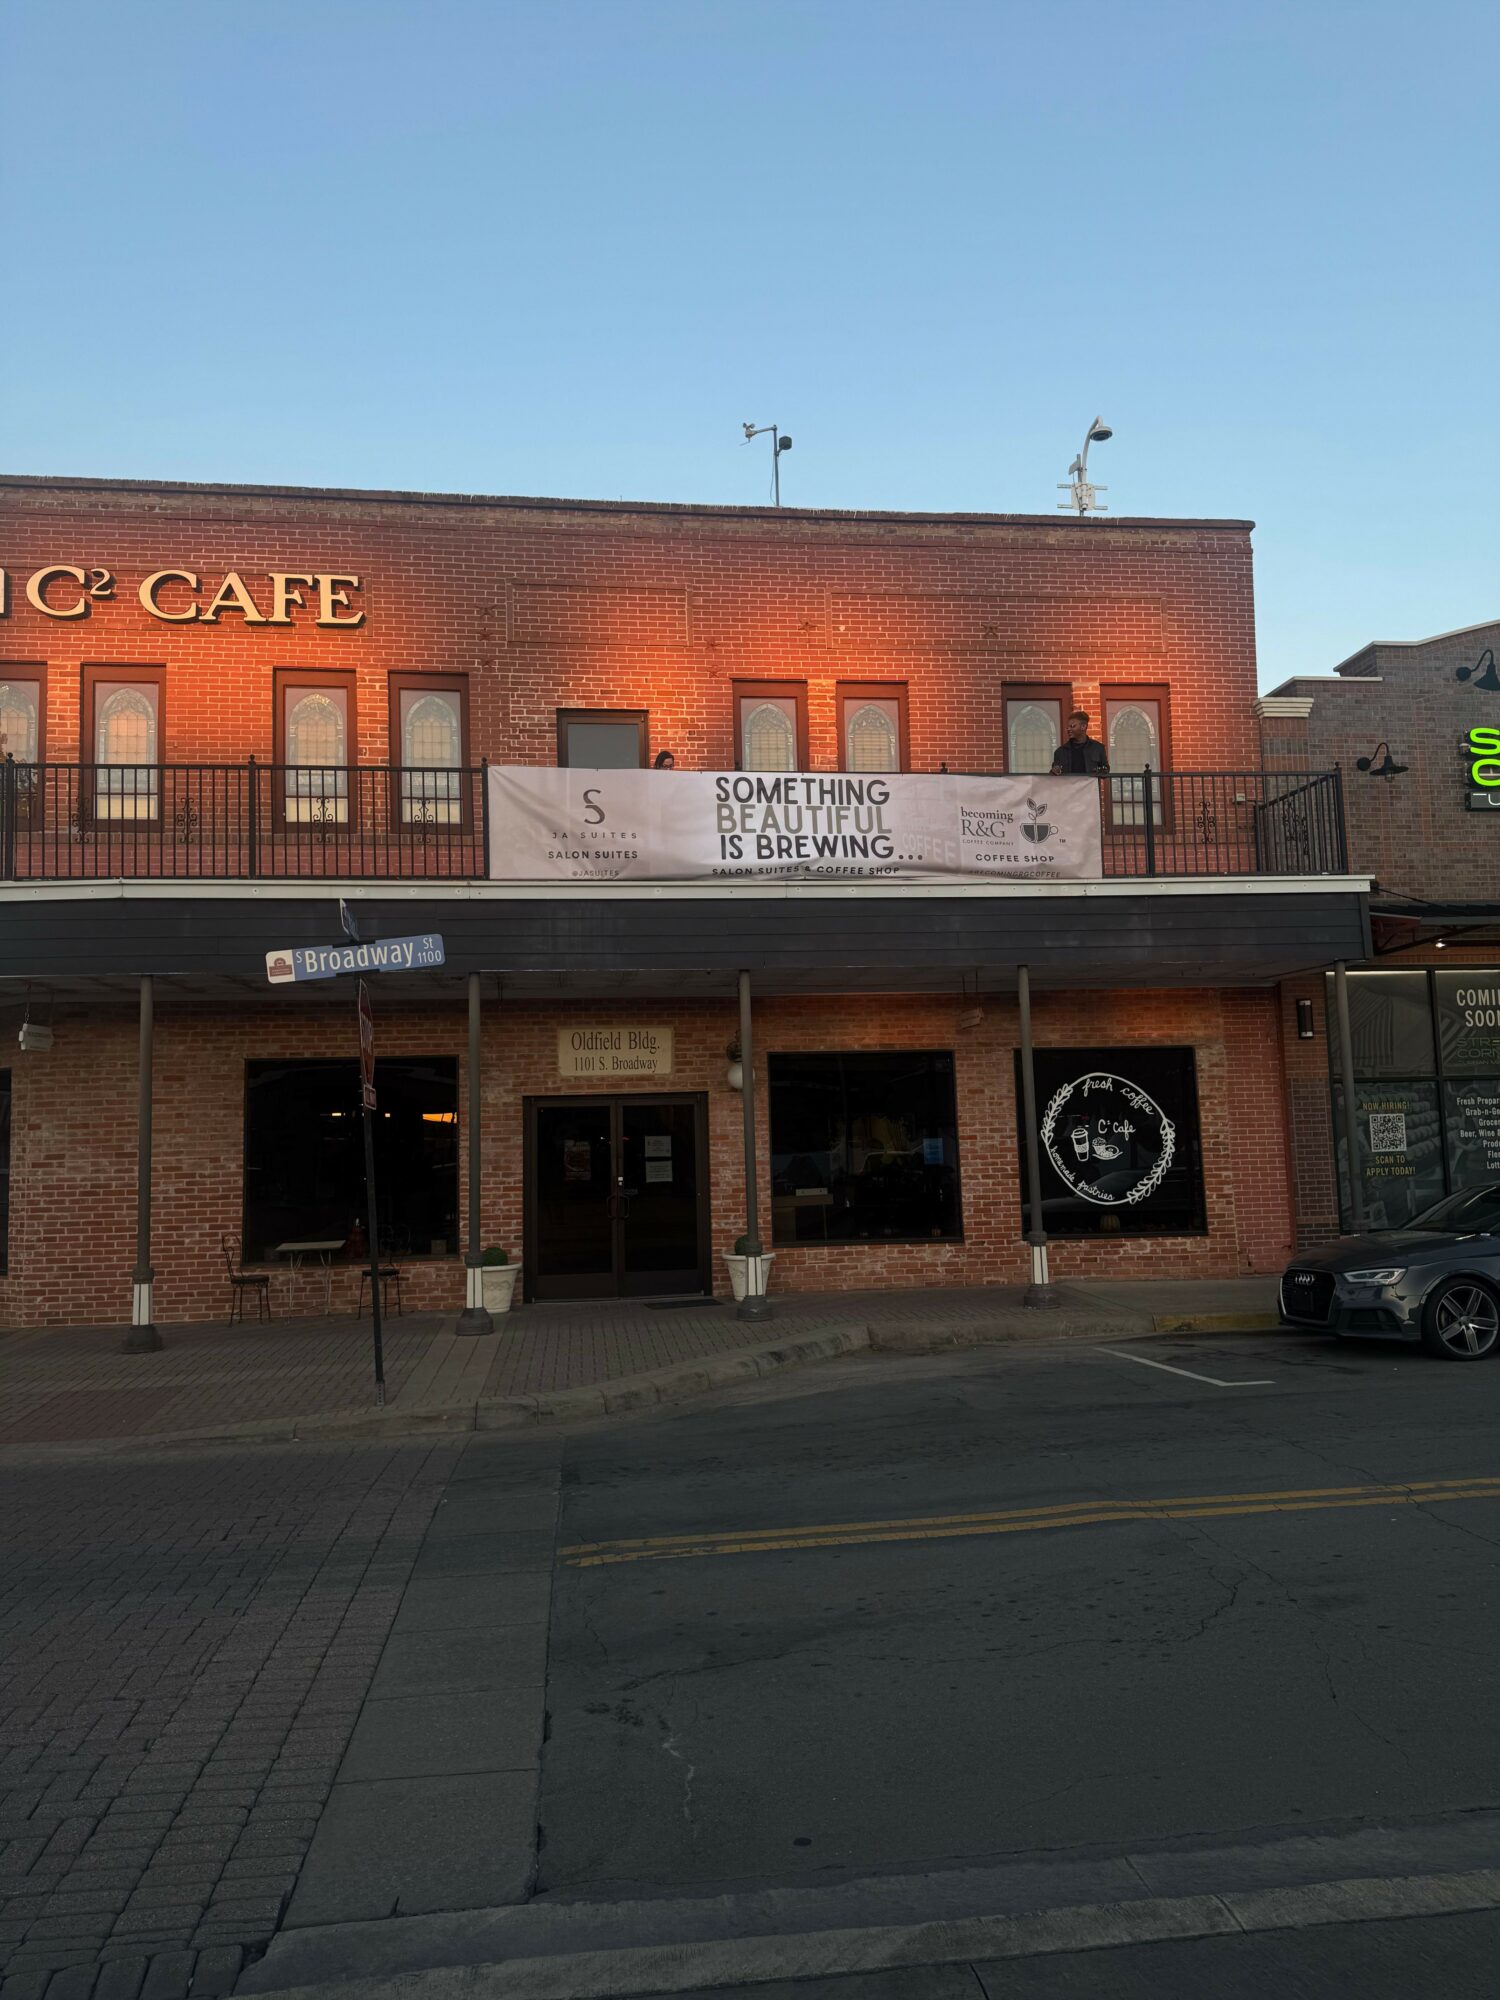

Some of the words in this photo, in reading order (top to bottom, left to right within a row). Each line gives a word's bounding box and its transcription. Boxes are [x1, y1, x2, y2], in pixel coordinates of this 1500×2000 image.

[139, 569, 365, 624] CAFE
[716, 776, 890, 806] SOMETHING
[717, 804, 892, 835] BEAUTIFUL
[960, 806, 1014, 824] becoming
[960, 819, 1006, 839] R&G
[548, 850, 590, 859] SALON
[595, 850, 639, 859] SUITES
[720, 834, 743, 860] IS
[975, 853, 1019, 863] COFFEE
[1024, 855, 1055, 863] SHOP
[712, 867, 753, 876] SALON
[758, 864, 800, 875] SUITES
[804, 865, 811, 873] &
[816, 865, 864, 876] COFFEE
[869, 867, 900, 877] SHOP
[296, 951, 303, 964] S
[304, 942, 414, 973] Broadway
[422, 936, 433, 950] St
[417, 950, 442, 965] 1100
[1456, 989, 1500, 1006] COMI
[571, 1031, 622, 1051] Oldfield
[628, 1031, 660, 1055] Bldg.
[575, 1056, 595, 1071] 1101
[599, 1056, 608, 1071] S.
[612, 1055, 658, 1073] Broadway
[1082, 1077, 1114, 1097] fresh
[1120, 1087, 1154, 1115] coffee
[1363, 1102, 1379, 1111] NOW
[1381, 1100, 1410, 1111] HIRING!
[1478, 1129, 1495, 1138] Wine
[1050, 1145, 1075, 1183] homemade
[1375, 1155, 1394, 1165] SCAN
[1396, 1154, 1406, 1164] TO
[1366, 1167, 1389, 1177] APPLY
[1391, 1166, 1416, 1176] TODAY!
[1077, 1180, 1116, 1201] pastries
